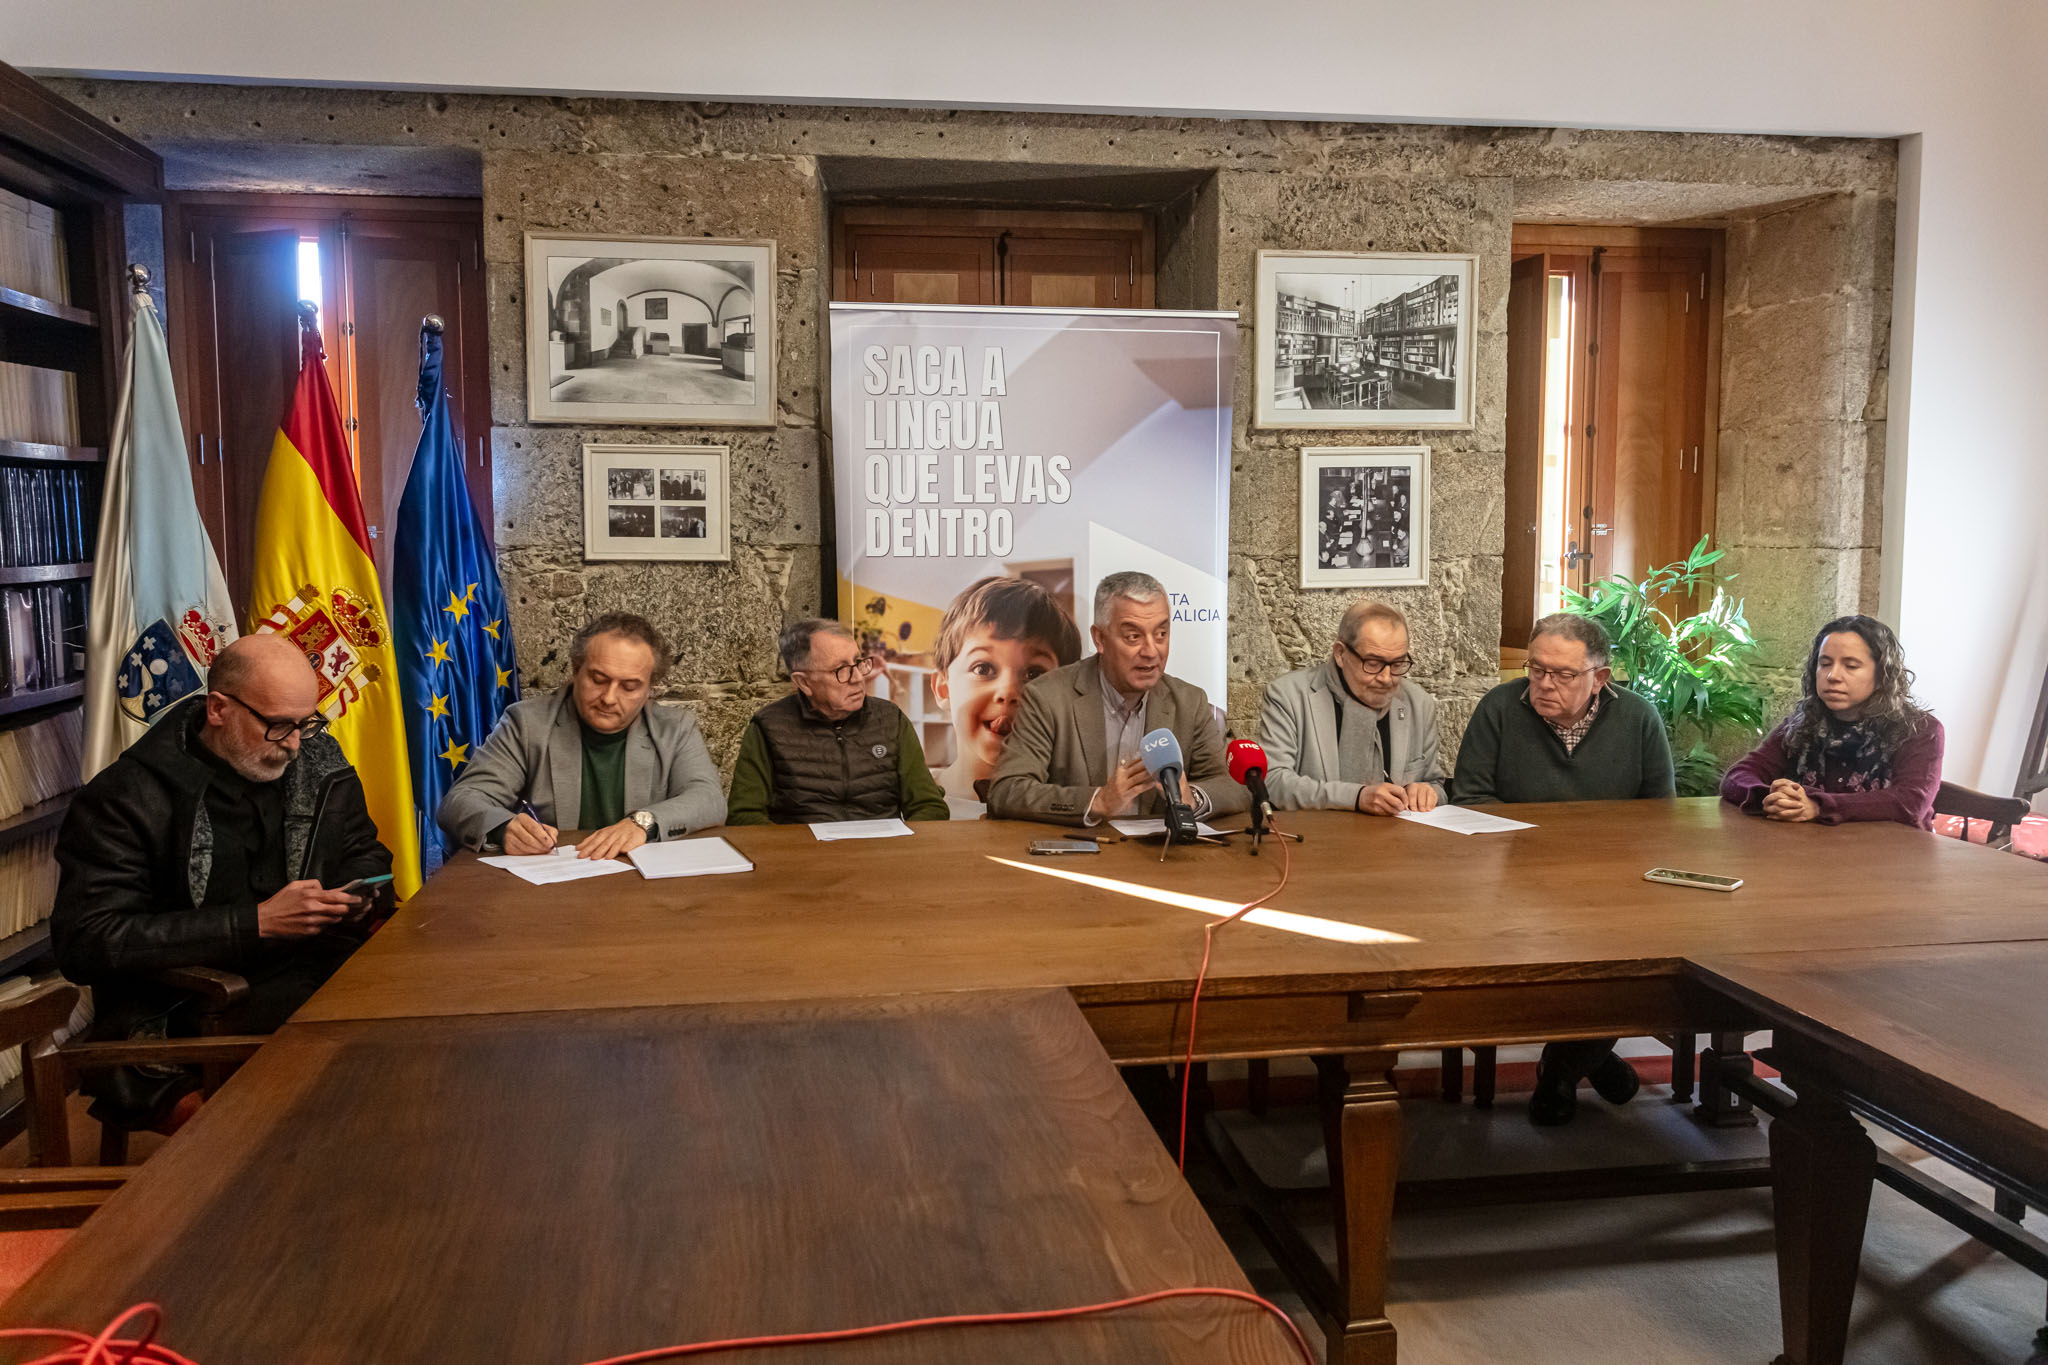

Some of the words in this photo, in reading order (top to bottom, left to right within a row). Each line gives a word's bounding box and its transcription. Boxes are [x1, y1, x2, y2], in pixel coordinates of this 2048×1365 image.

[863, 345, 968, 396] SACA
[980, 346, 1007, 396] A
[864, 399, 1004, 450] LINGUA
[864, 454, 940, 508] QUE
[953, 454, 1072, 504] LEVAS
[865, 508, 1014, 557] DENTRO
[1169, 593, 1190, 606] TA
[1172, 609, 1221, 622] ALICIA
[1144, 736, 1170, 752] tve
